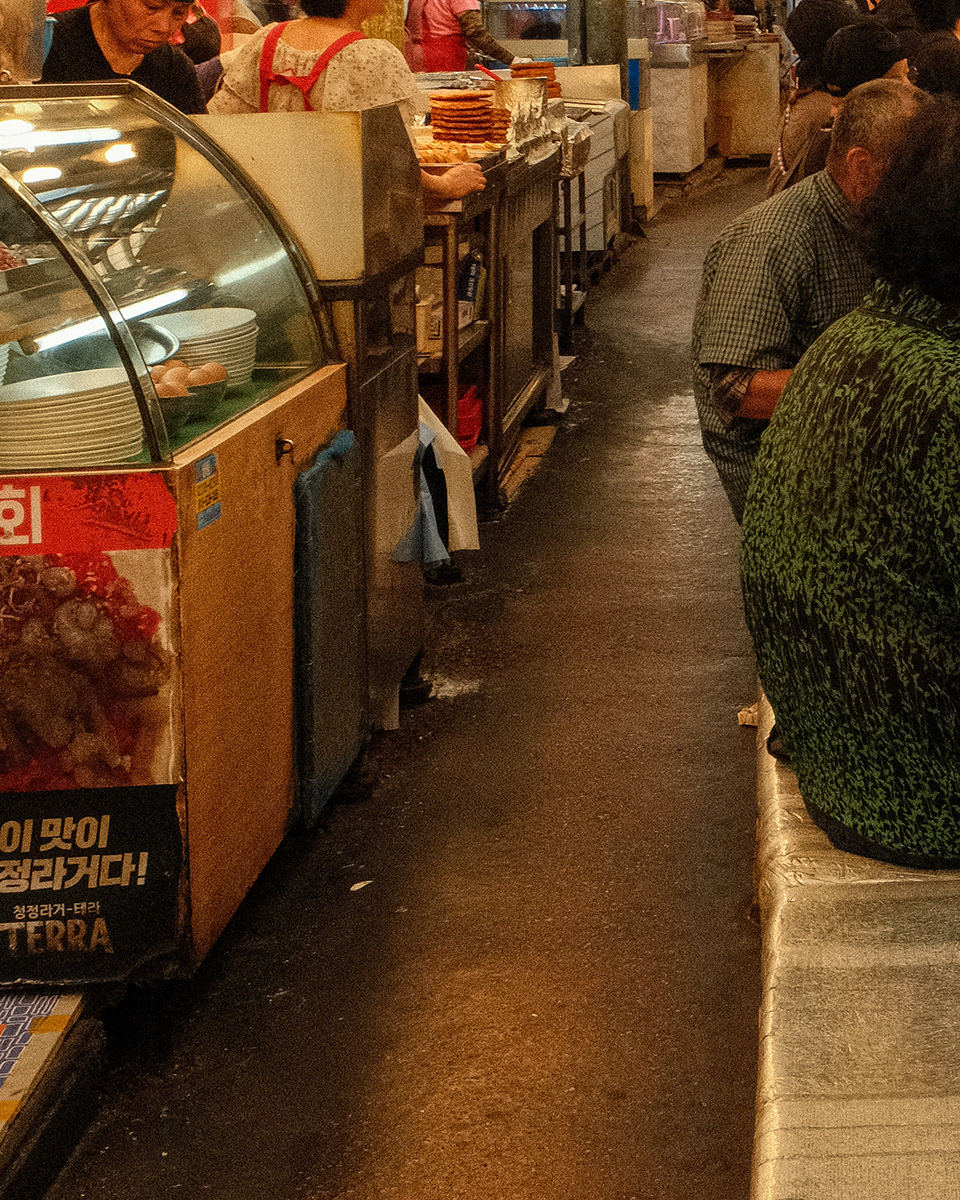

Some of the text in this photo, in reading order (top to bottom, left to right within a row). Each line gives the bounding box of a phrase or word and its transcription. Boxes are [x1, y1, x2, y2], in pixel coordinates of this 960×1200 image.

[39, 814, 111, 851] 맛이
[12, 901, 101, 920] 청정라거-테라
[0, 917, 115, 955] TERRA
